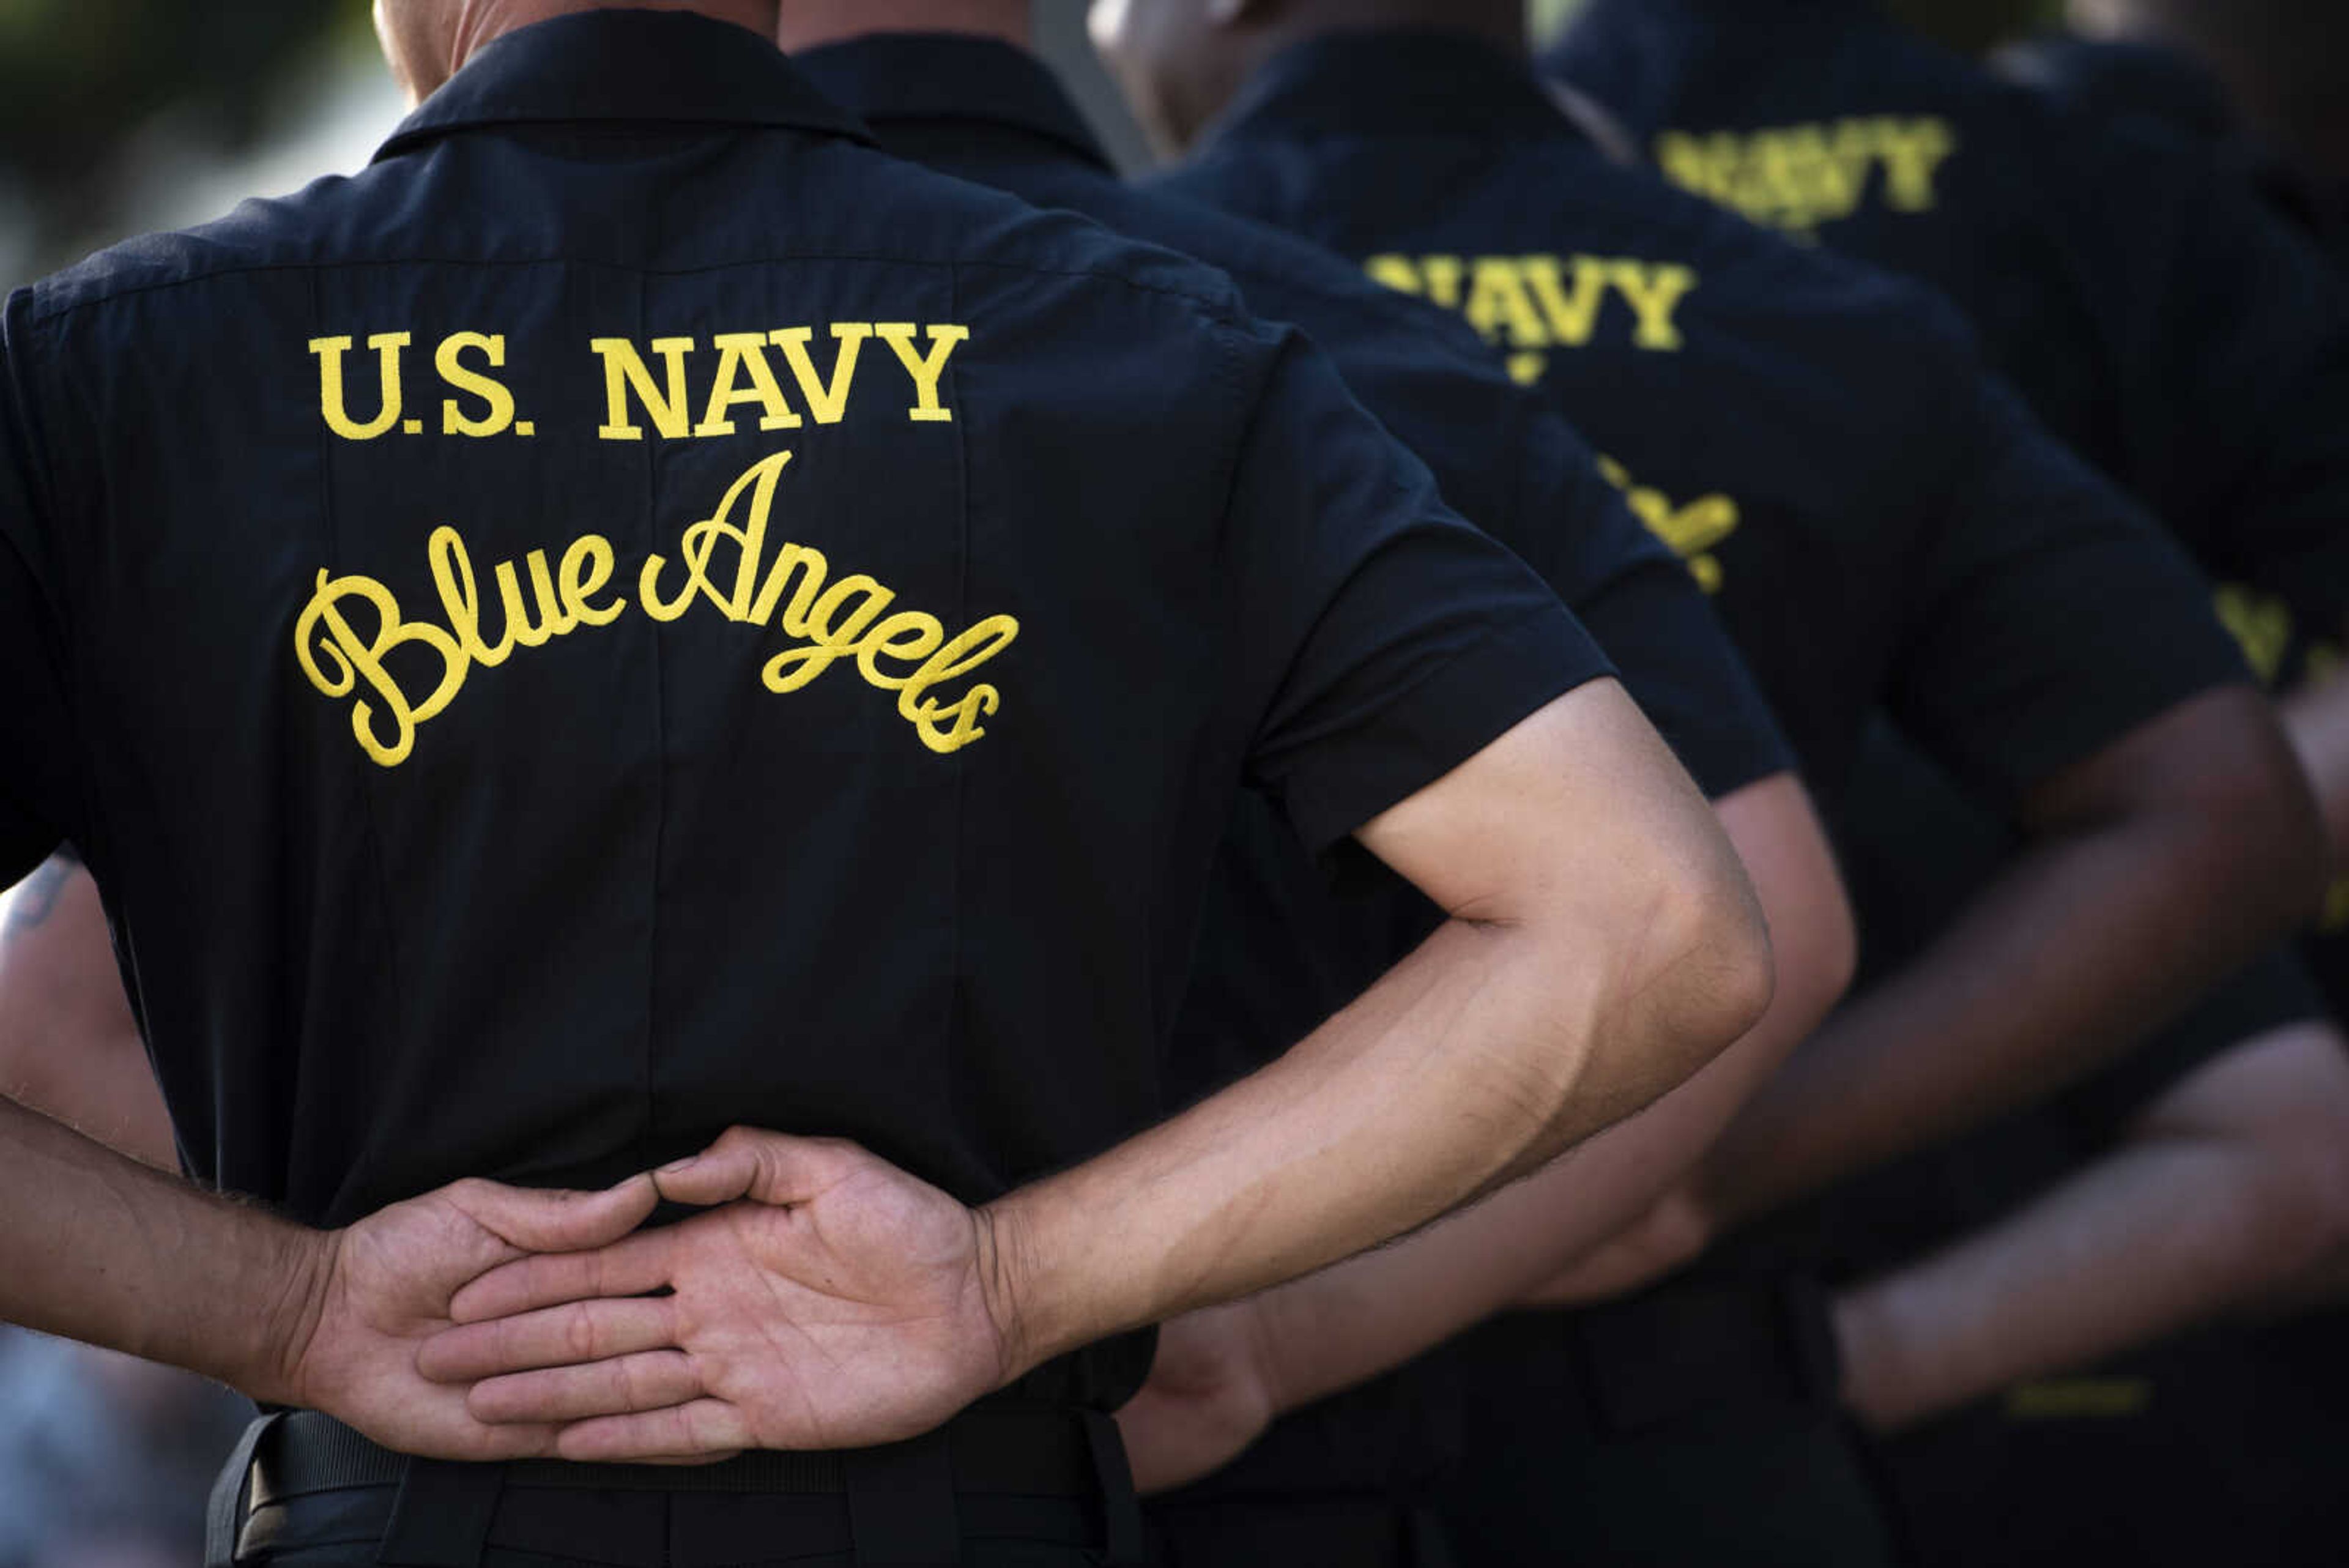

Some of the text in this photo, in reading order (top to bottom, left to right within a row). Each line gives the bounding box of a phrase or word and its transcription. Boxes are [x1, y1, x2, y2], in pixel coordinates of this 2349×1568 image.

[309, 322, 970, 440] U.S. NAVY
[294, 450, 1020, 767] Blue Angels
